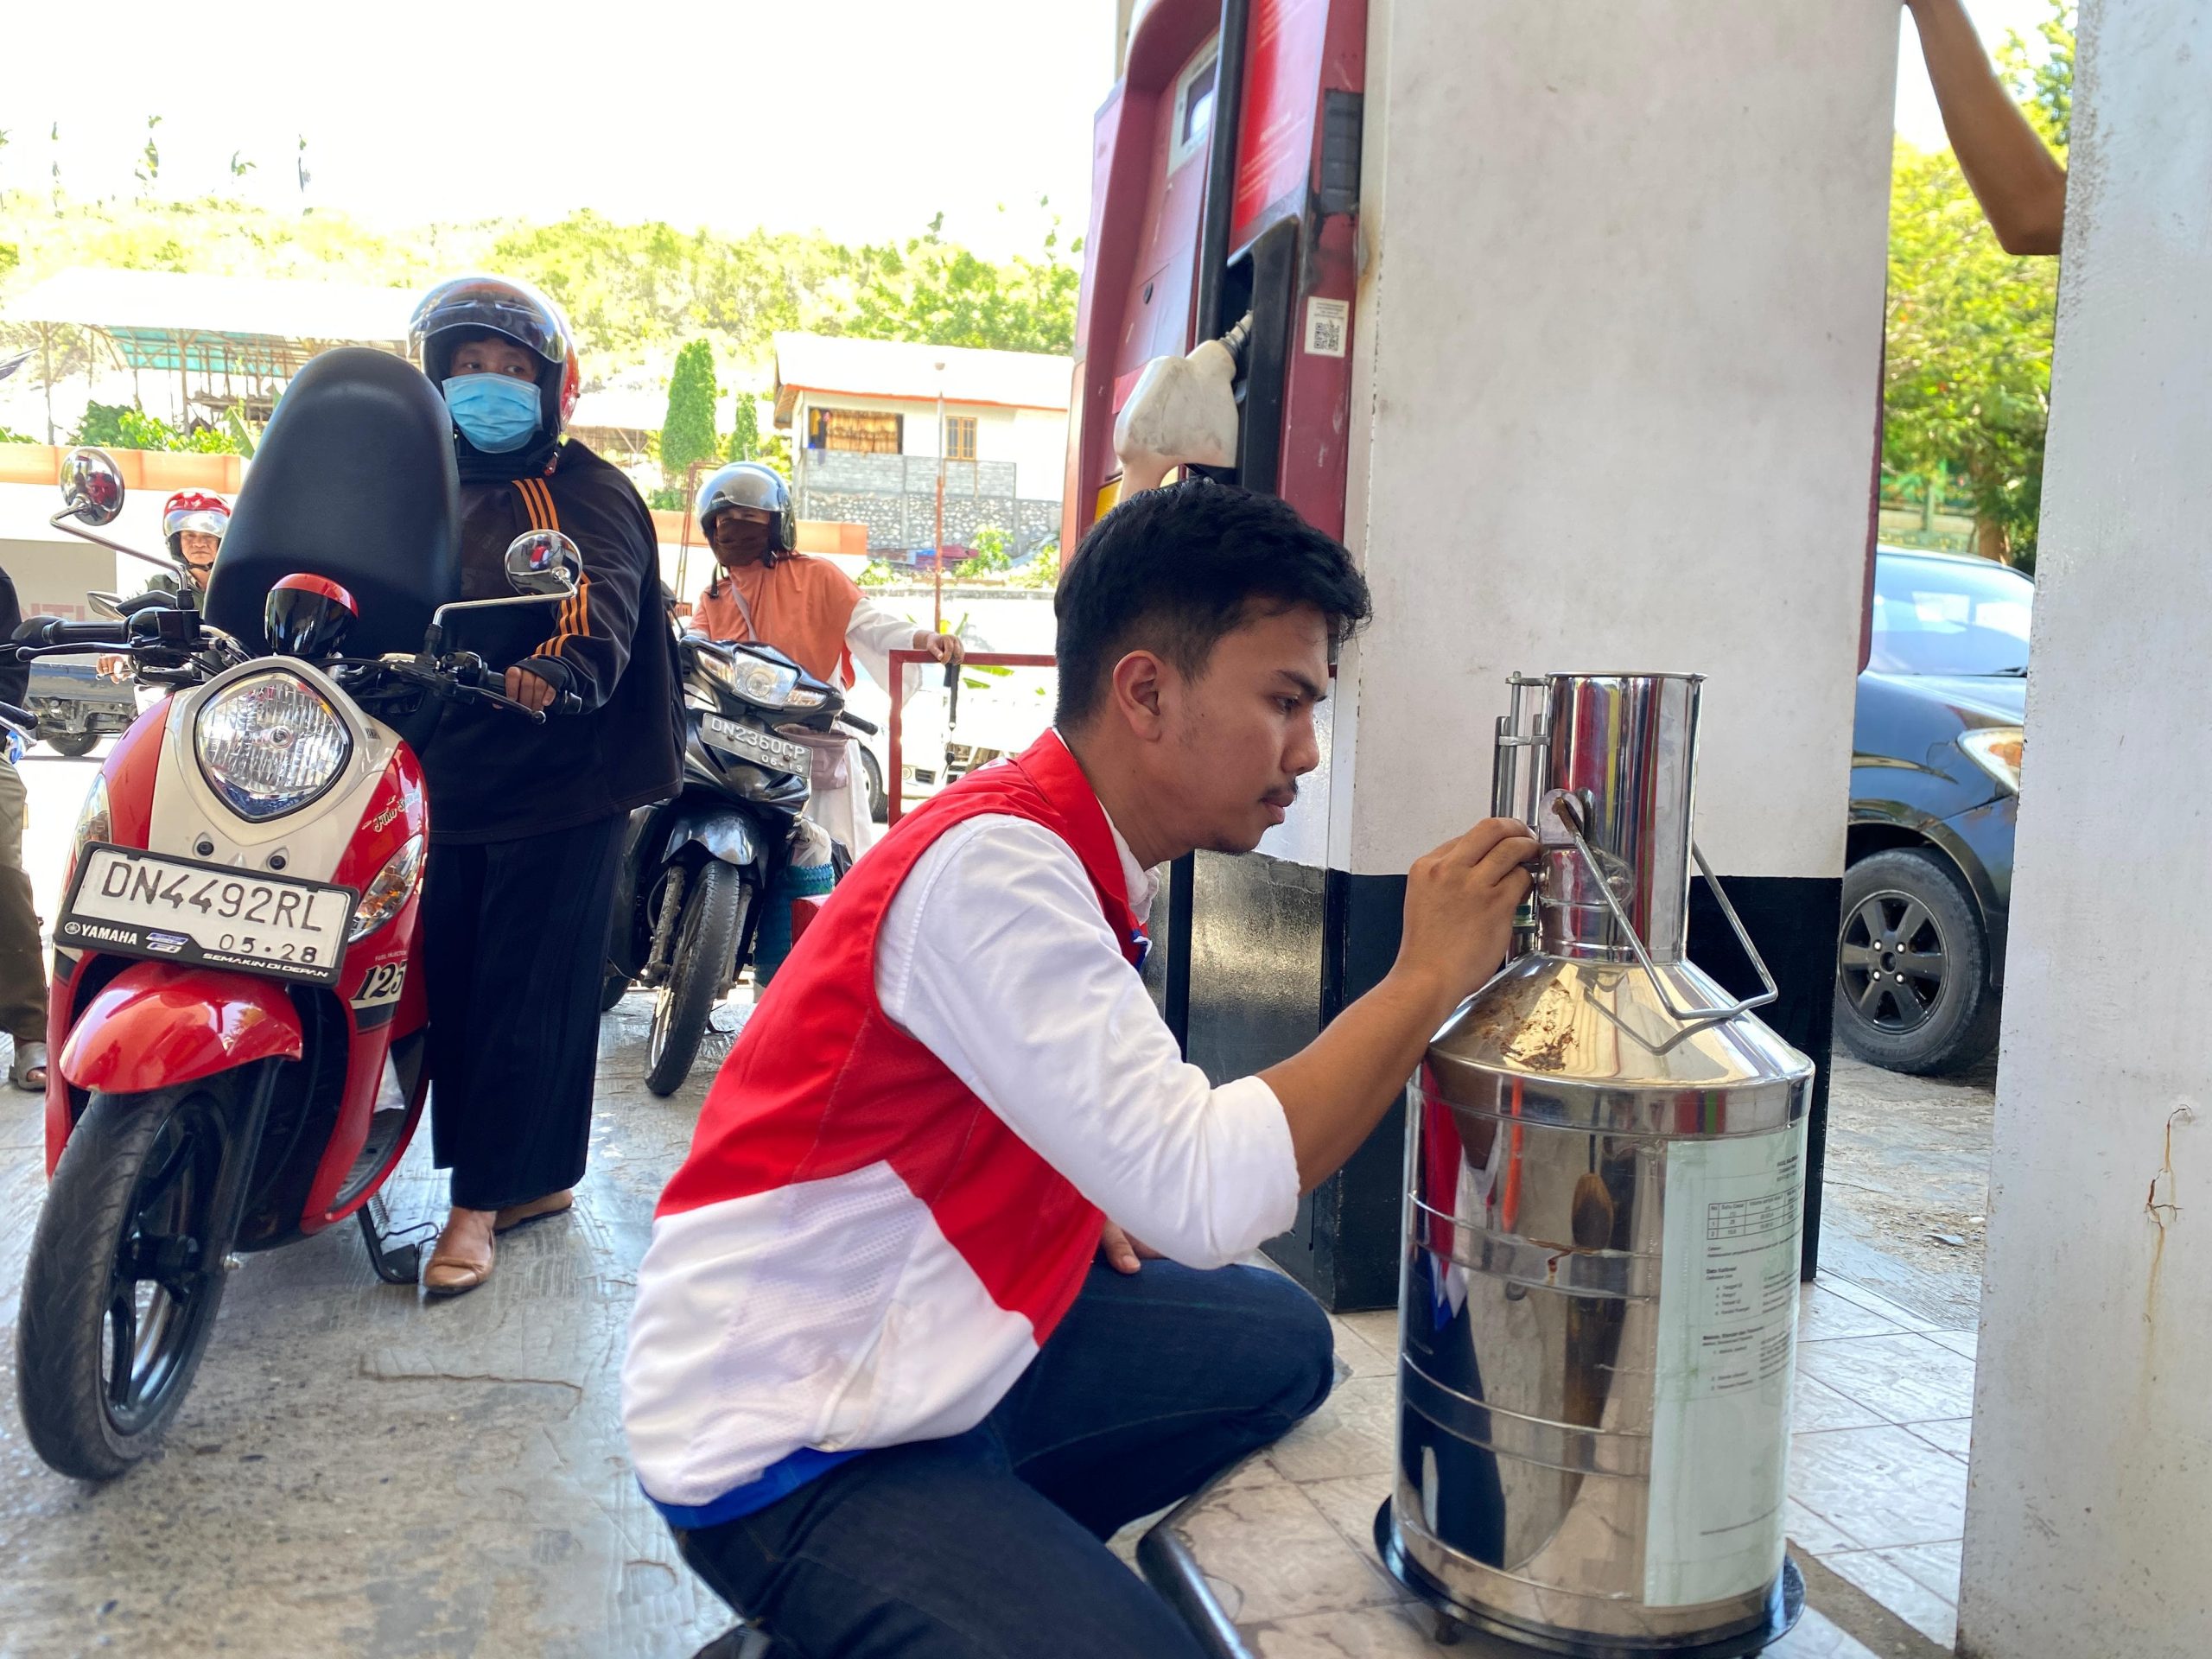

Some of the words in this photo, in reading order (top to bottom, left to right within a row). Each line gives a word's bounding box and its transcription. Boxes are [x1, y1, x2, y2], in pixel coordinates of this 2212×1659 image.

[711, 717, 805, 760] DN2360CP
[102, 861, 321, 931] DN4492RL
[81, 924, 137, 944] YAMAHA
[350, 961, 407, 1000] 125
